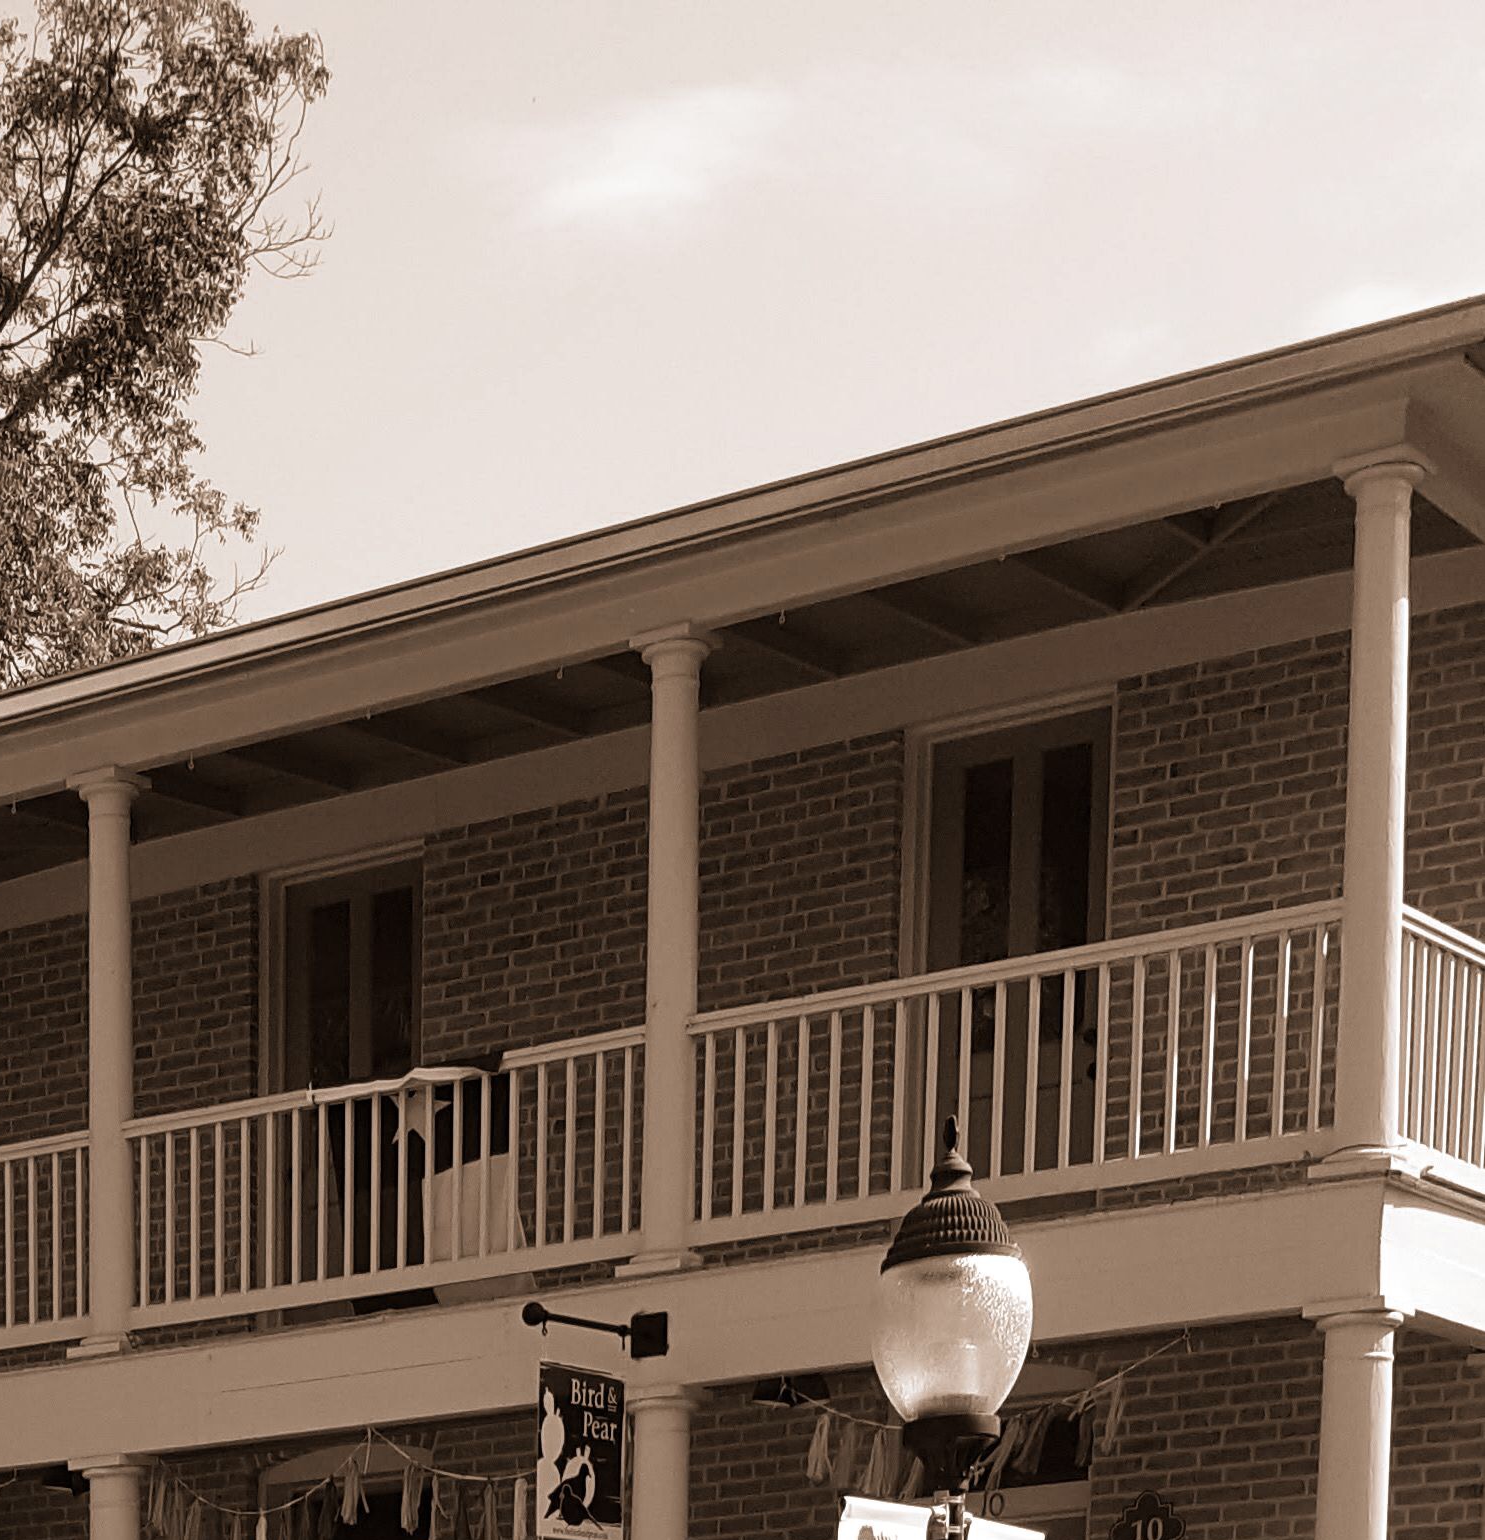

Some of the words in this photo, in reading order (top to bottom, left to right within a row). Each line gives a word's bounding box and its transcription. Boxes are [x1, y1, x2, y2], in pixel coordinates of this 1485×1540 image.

[570, 1378, 605, 1409] Bird
[607, 1386, 618, 1413] &
[583, 1410, 618, 1444] Pear
